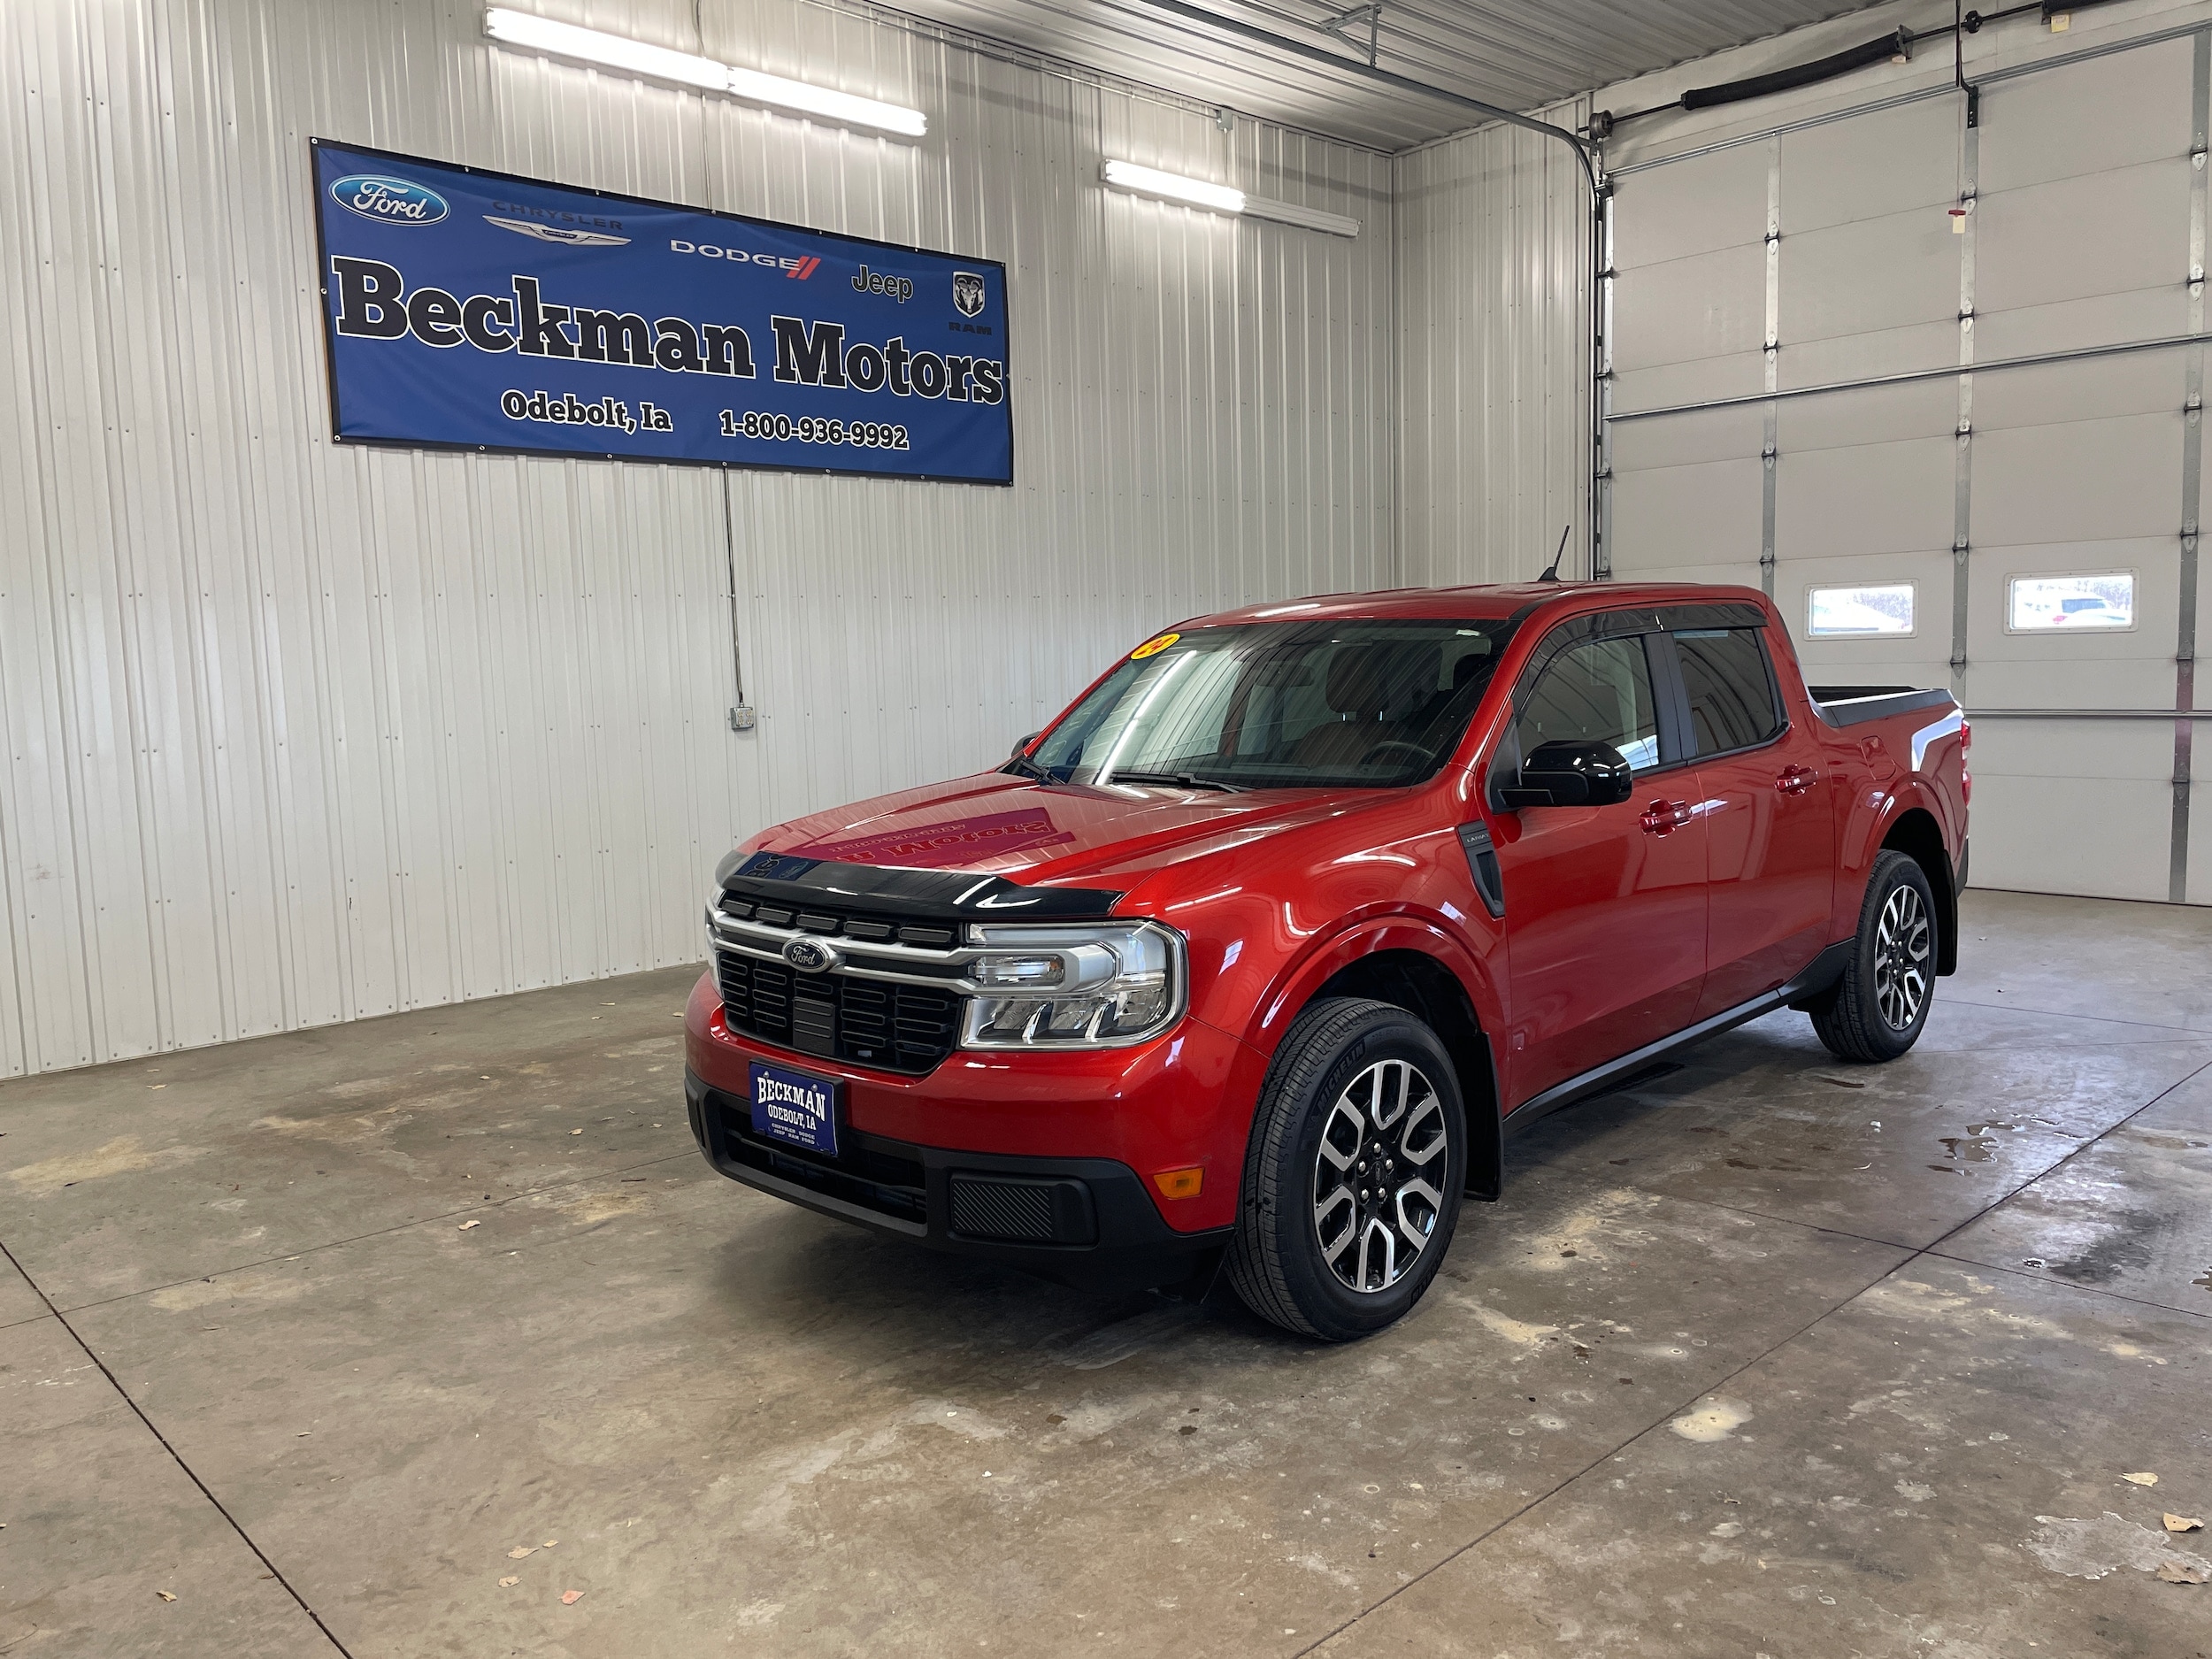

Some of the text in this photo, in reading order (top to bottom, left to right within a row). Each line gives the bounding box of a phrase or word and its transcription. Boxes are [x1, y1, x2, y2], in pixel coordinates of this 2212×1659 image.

[353, 179, 428, 220] Ford
[493, 201, 624, 230] CHRYSLER
[670, 239, 801, 272] DODGE
[851, 265, 913, 303] Jeep
[331, 255, 1003, 405] Beckman Motors
[949, 321, 993, 335] RAM
[501, 388, 910, 450] Odebolt, Ia 1-800-936-9992
[791, 946, 816, 965] Ford
[1316, 1041, 1364, 1113] MICHELIN
[757, 1077, 826, 1121] BECKMAN
